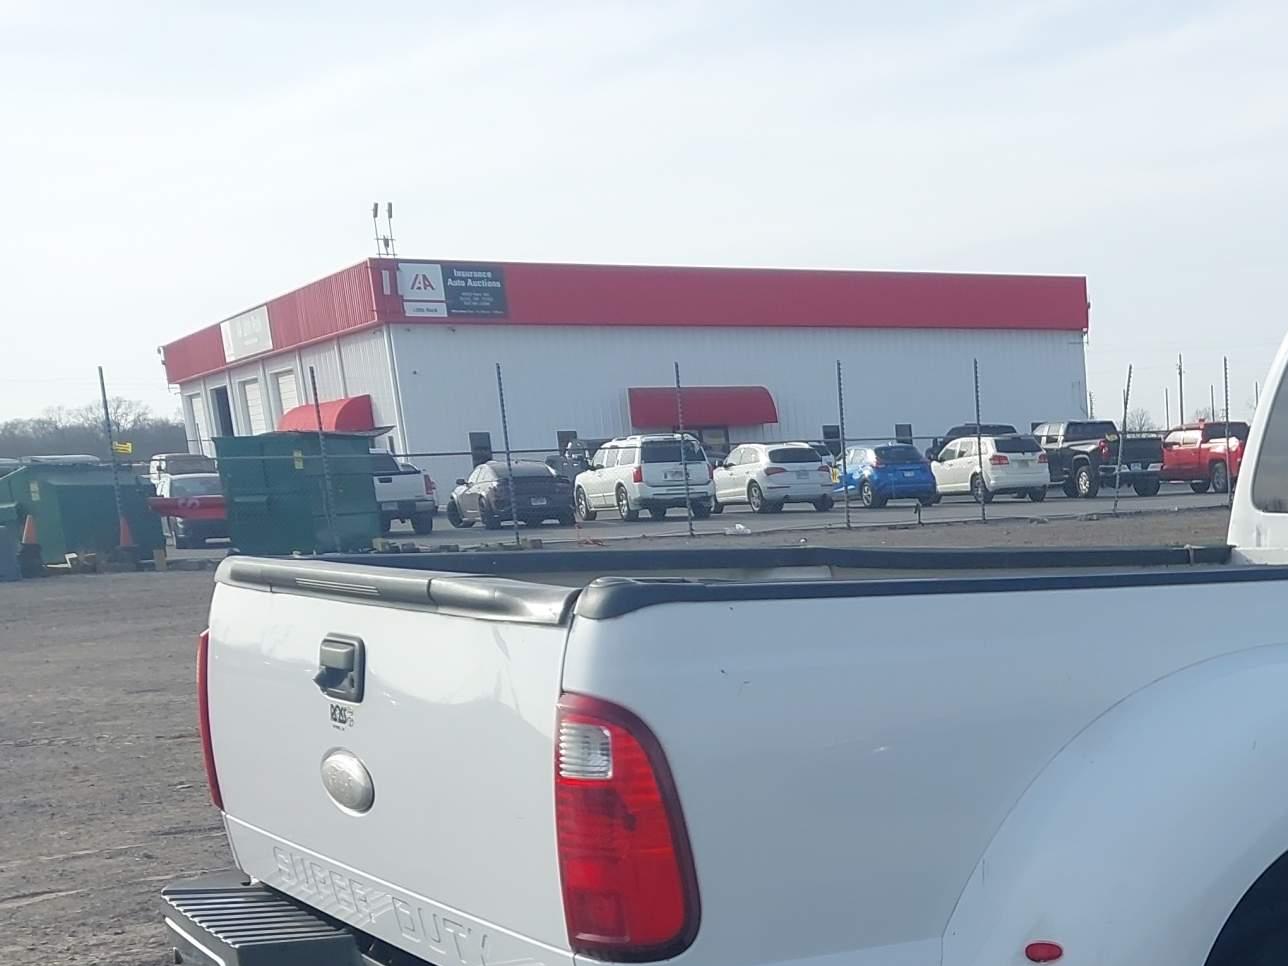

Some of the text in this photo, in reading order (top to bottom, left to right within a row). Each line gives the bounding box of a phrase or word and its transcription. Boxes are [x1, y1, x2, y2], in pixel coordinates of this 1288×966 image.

[453, 268, 492, 278] Insurance
[447, 278, 501, 288] Auto Auctions
